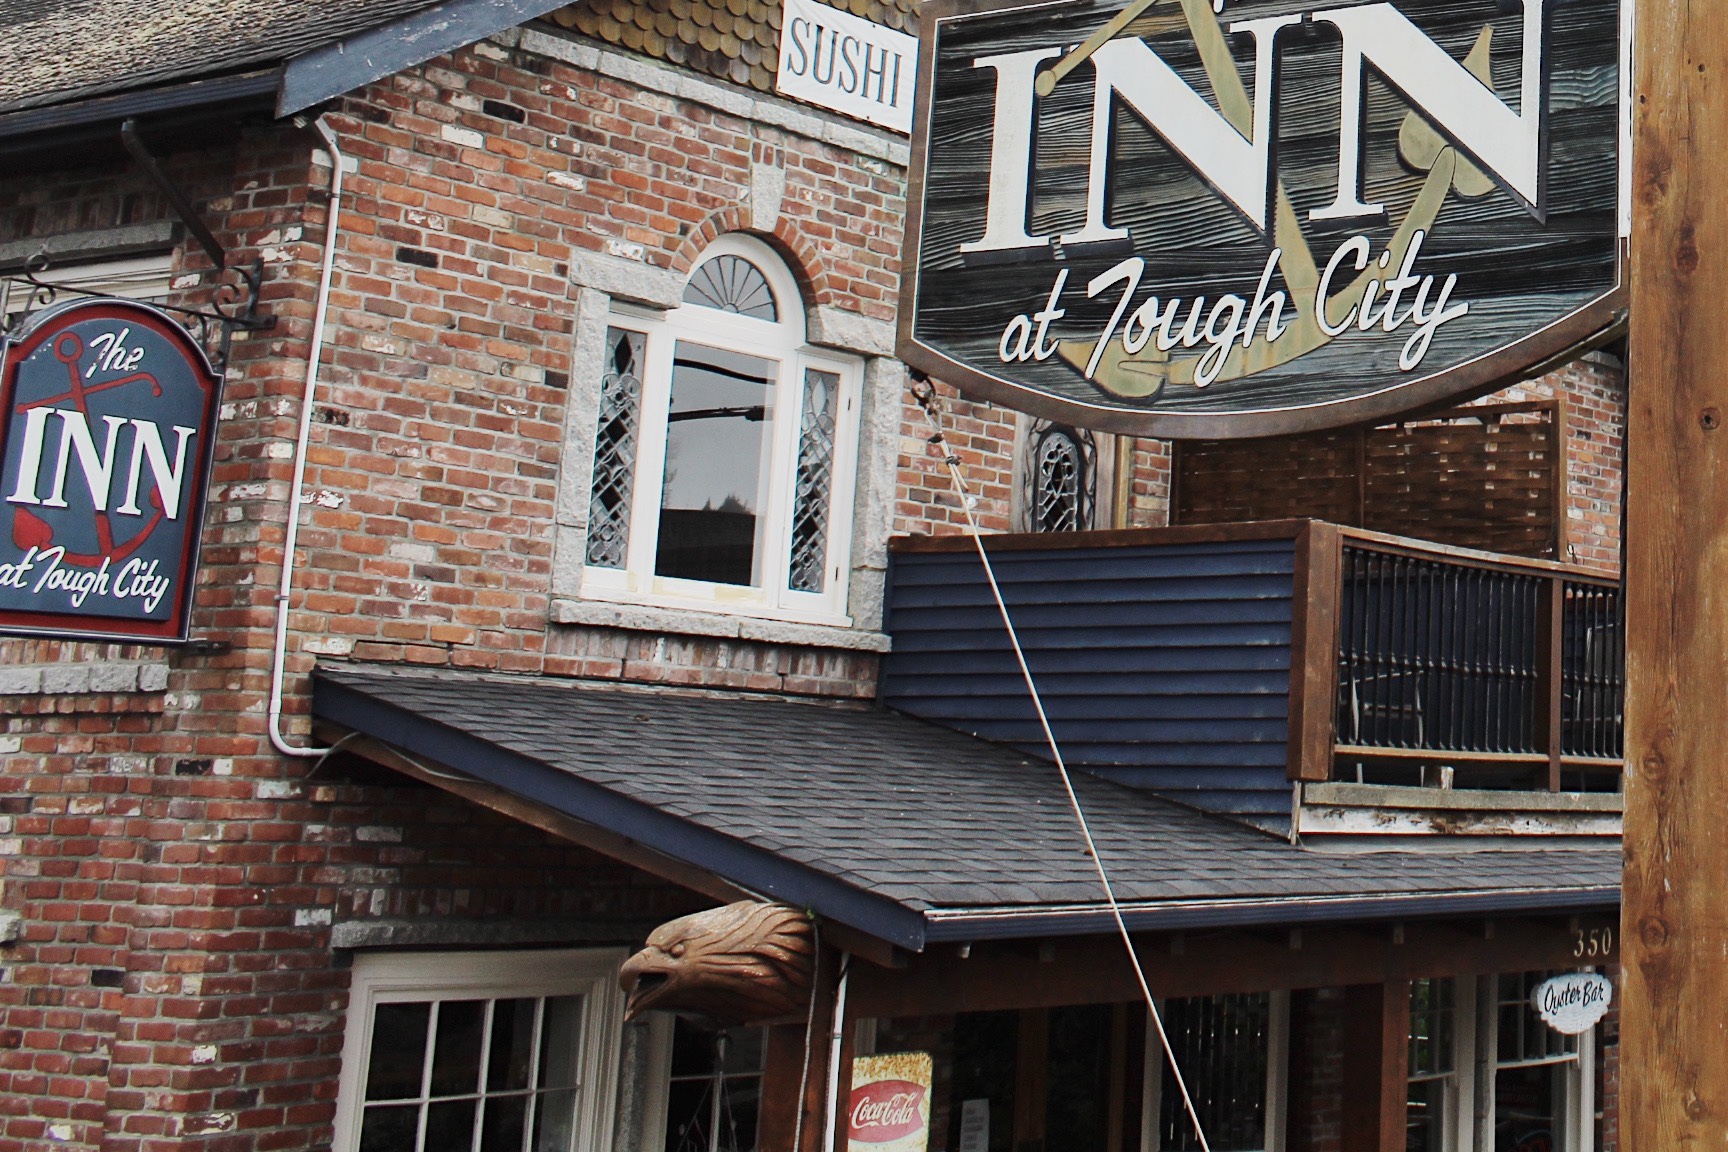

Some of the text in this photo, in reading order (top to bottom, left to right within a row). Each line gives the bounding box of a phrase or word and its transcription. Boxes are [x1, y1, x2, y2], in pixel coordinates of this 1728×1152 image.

[787, 16, 902, 109] SUSHI
[1000, 230, 1469, 387] at Tough City
[86, 328, 145, 379] The
[6, 405, 197, 521] INN
[0, 545, 170, 614] at Tough City
[1574, 926, 1612, 957] 350
[1544, 980, 1604, 1015] Oyster Bar
